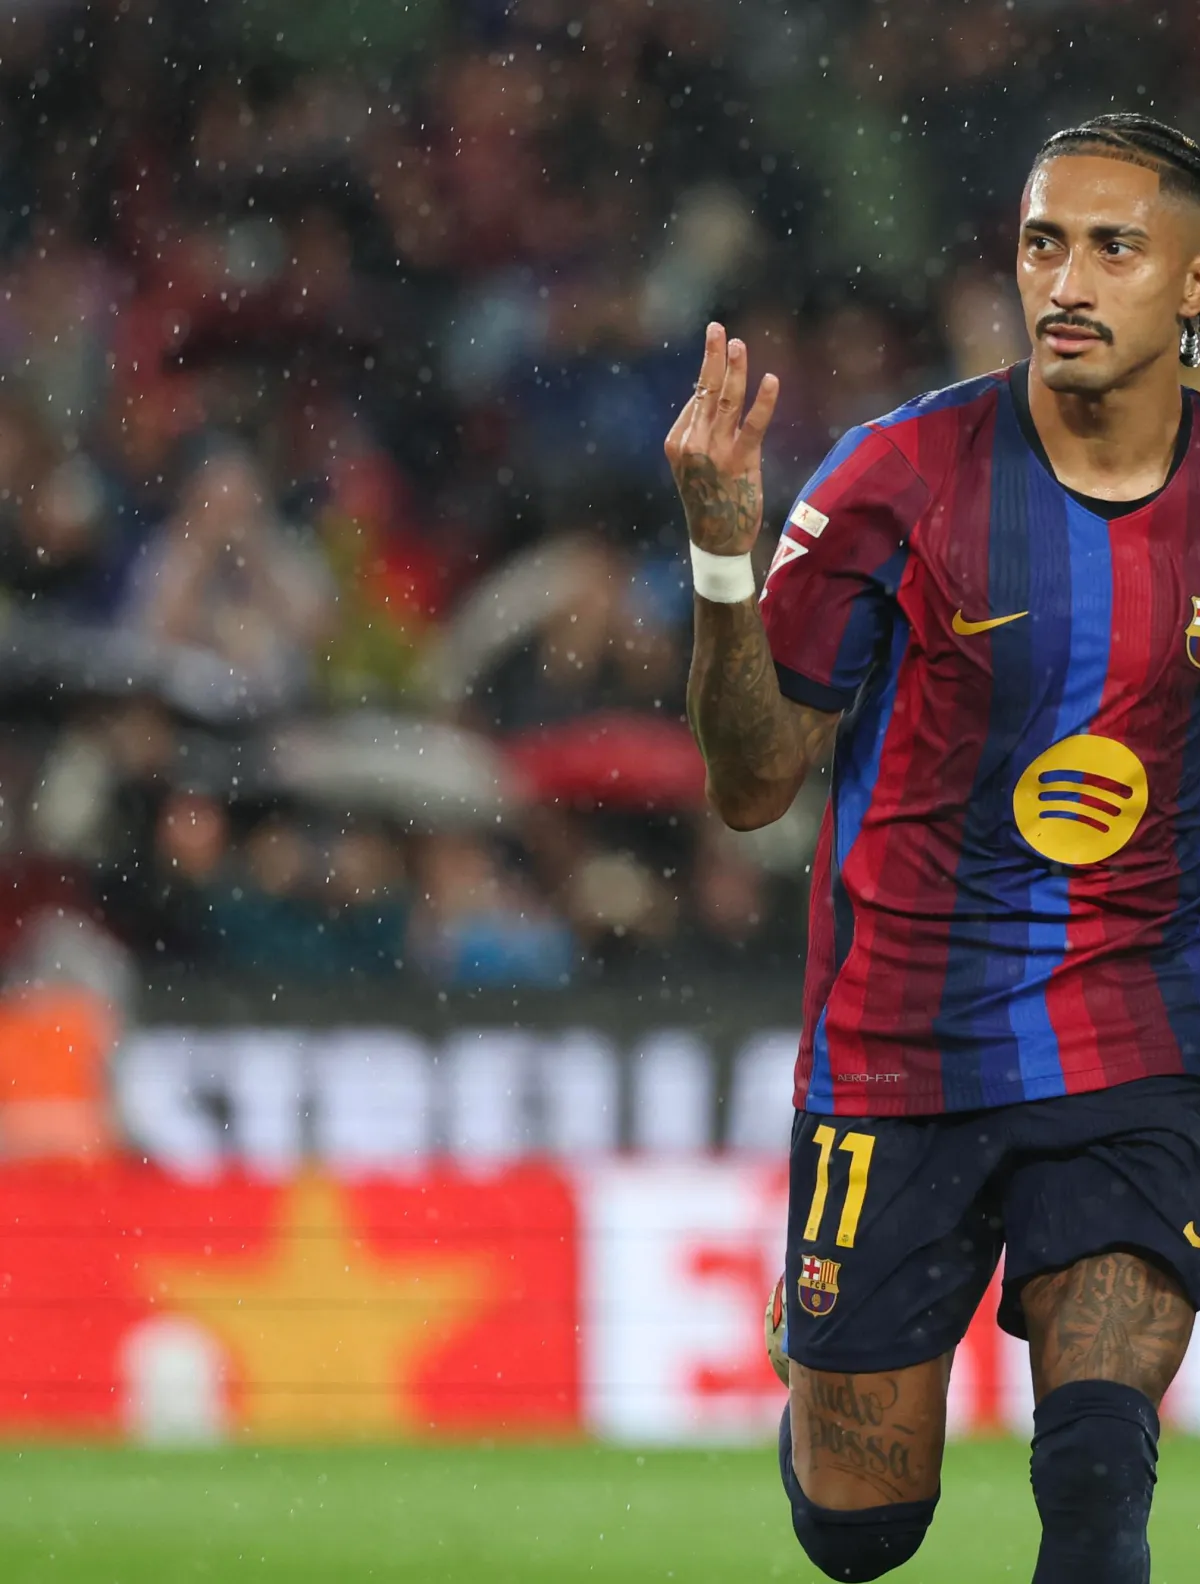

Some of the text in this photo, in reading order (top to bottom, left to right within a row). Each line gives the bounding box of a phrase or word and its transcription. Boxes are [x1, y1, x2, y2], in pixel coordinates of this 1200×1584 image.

[837, 1073, 900, 1082] AERO-FIT
[803, 1124, 876, 1248] 11
[809, 1280, 826, 1290] FCB
